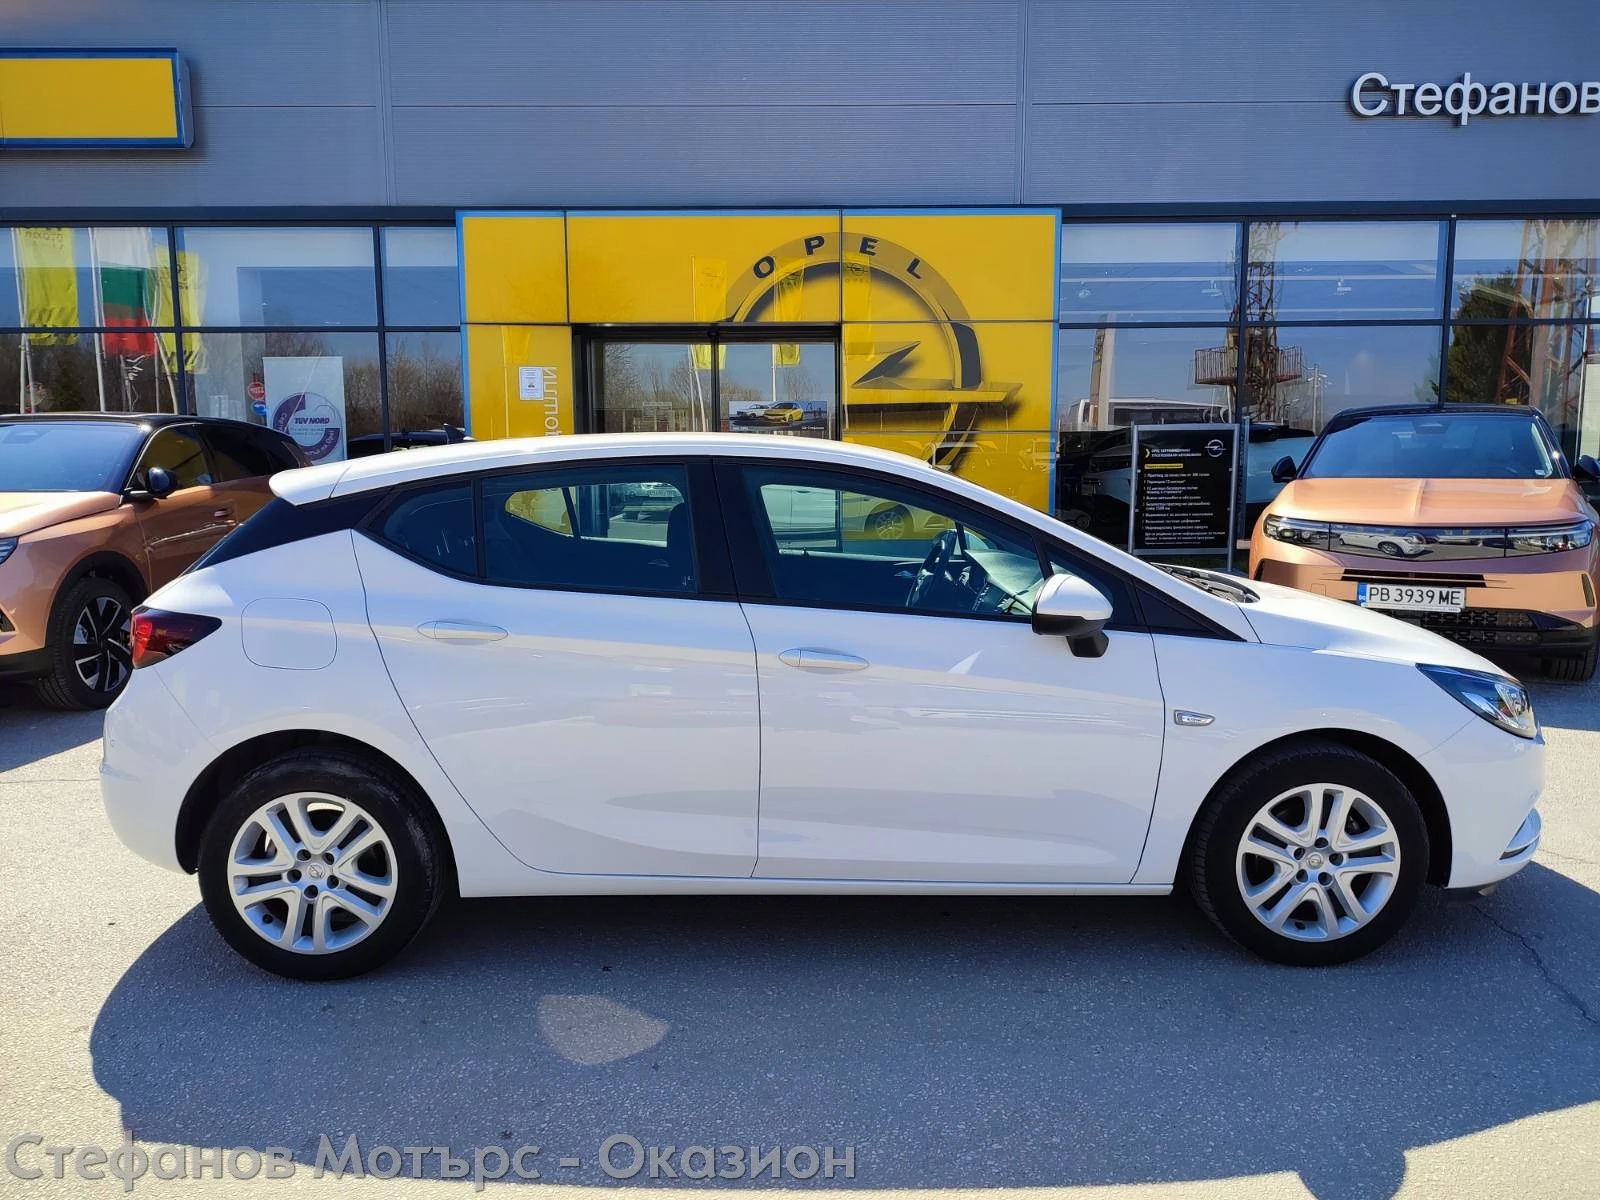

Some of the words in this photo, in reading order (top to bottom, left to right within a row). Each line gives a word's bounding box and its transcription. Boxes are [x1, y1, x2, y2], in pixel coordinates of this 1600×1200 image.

[1352, 72, 1600, 125] Стефанов
[753, 235, 923, 279] OPEL
[309, 417, 330, 425] NORD
[1369, 587, 1390, 602] PB
[1394, 588, 1435, 604] 3939
[1438, 590, 1461, 605] ME
